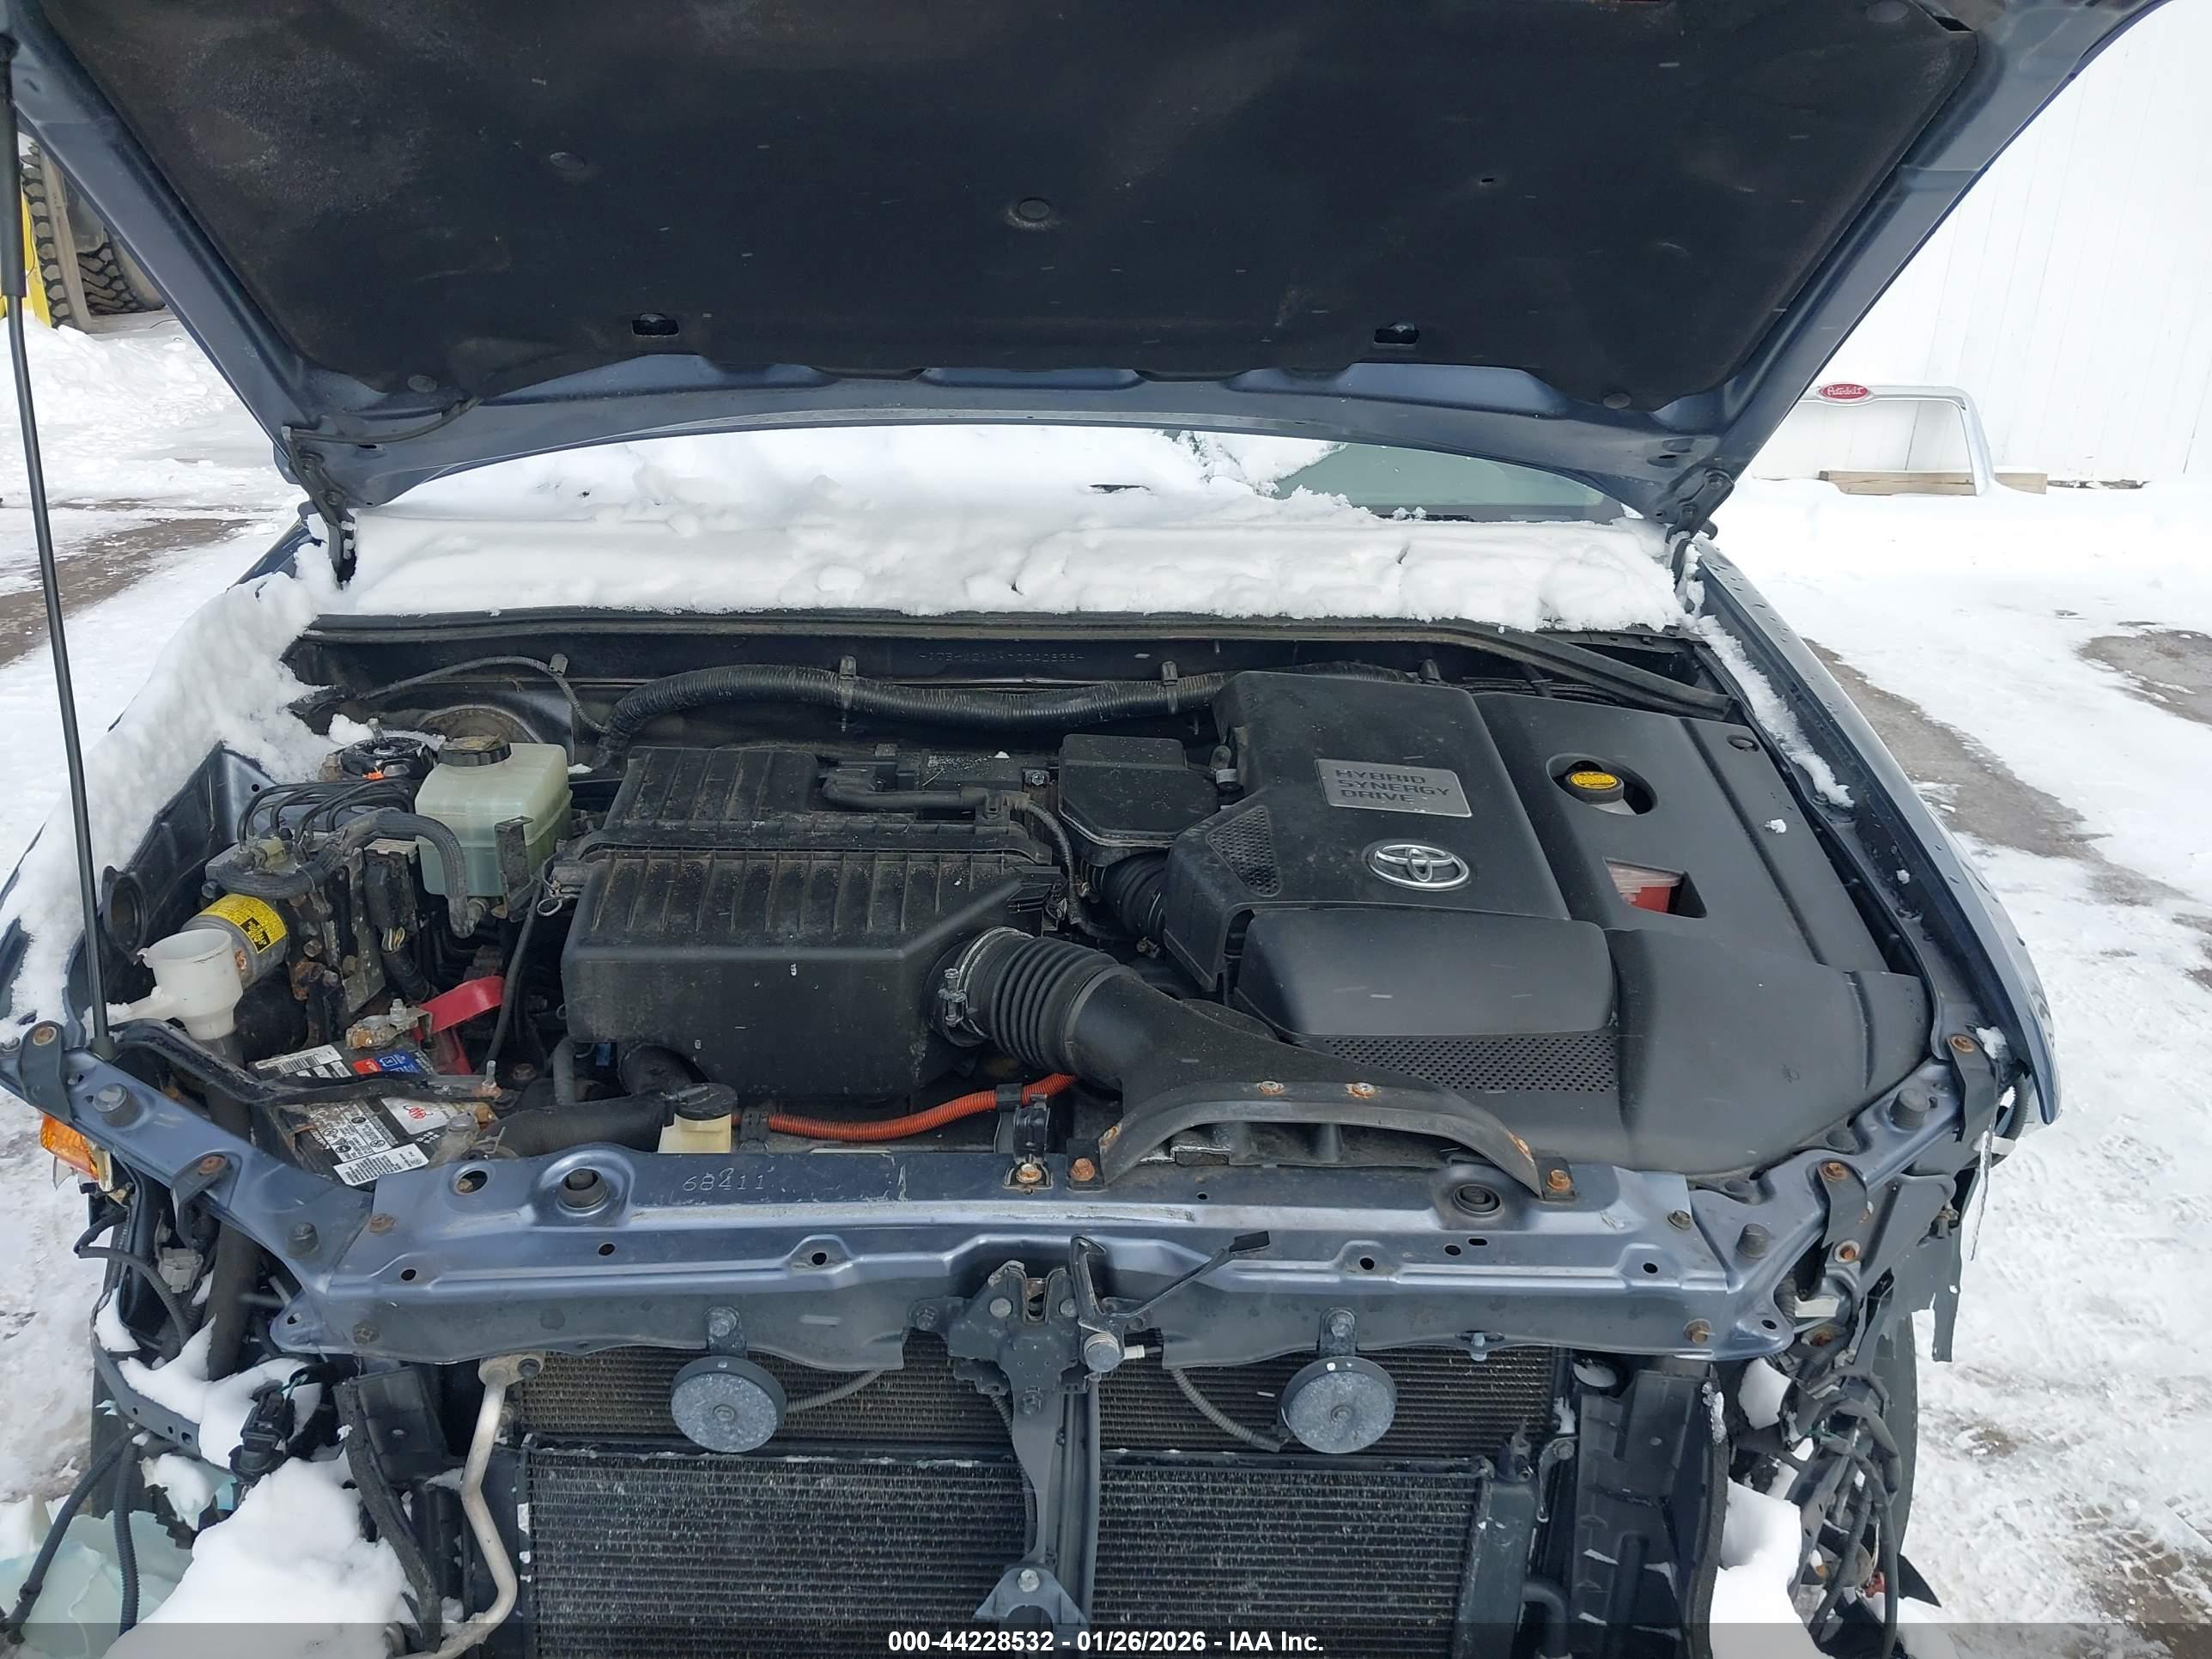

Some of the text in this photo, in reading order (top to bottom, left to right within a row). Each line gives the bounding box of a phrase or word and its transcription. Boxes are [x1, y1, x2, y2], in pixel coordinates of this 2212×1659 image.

[1335, 769, 1425, 784] HYBRID
[1338, 780, 1450, 796] SYNERGY
[1340, 789, 1416, 803] DRIVE
